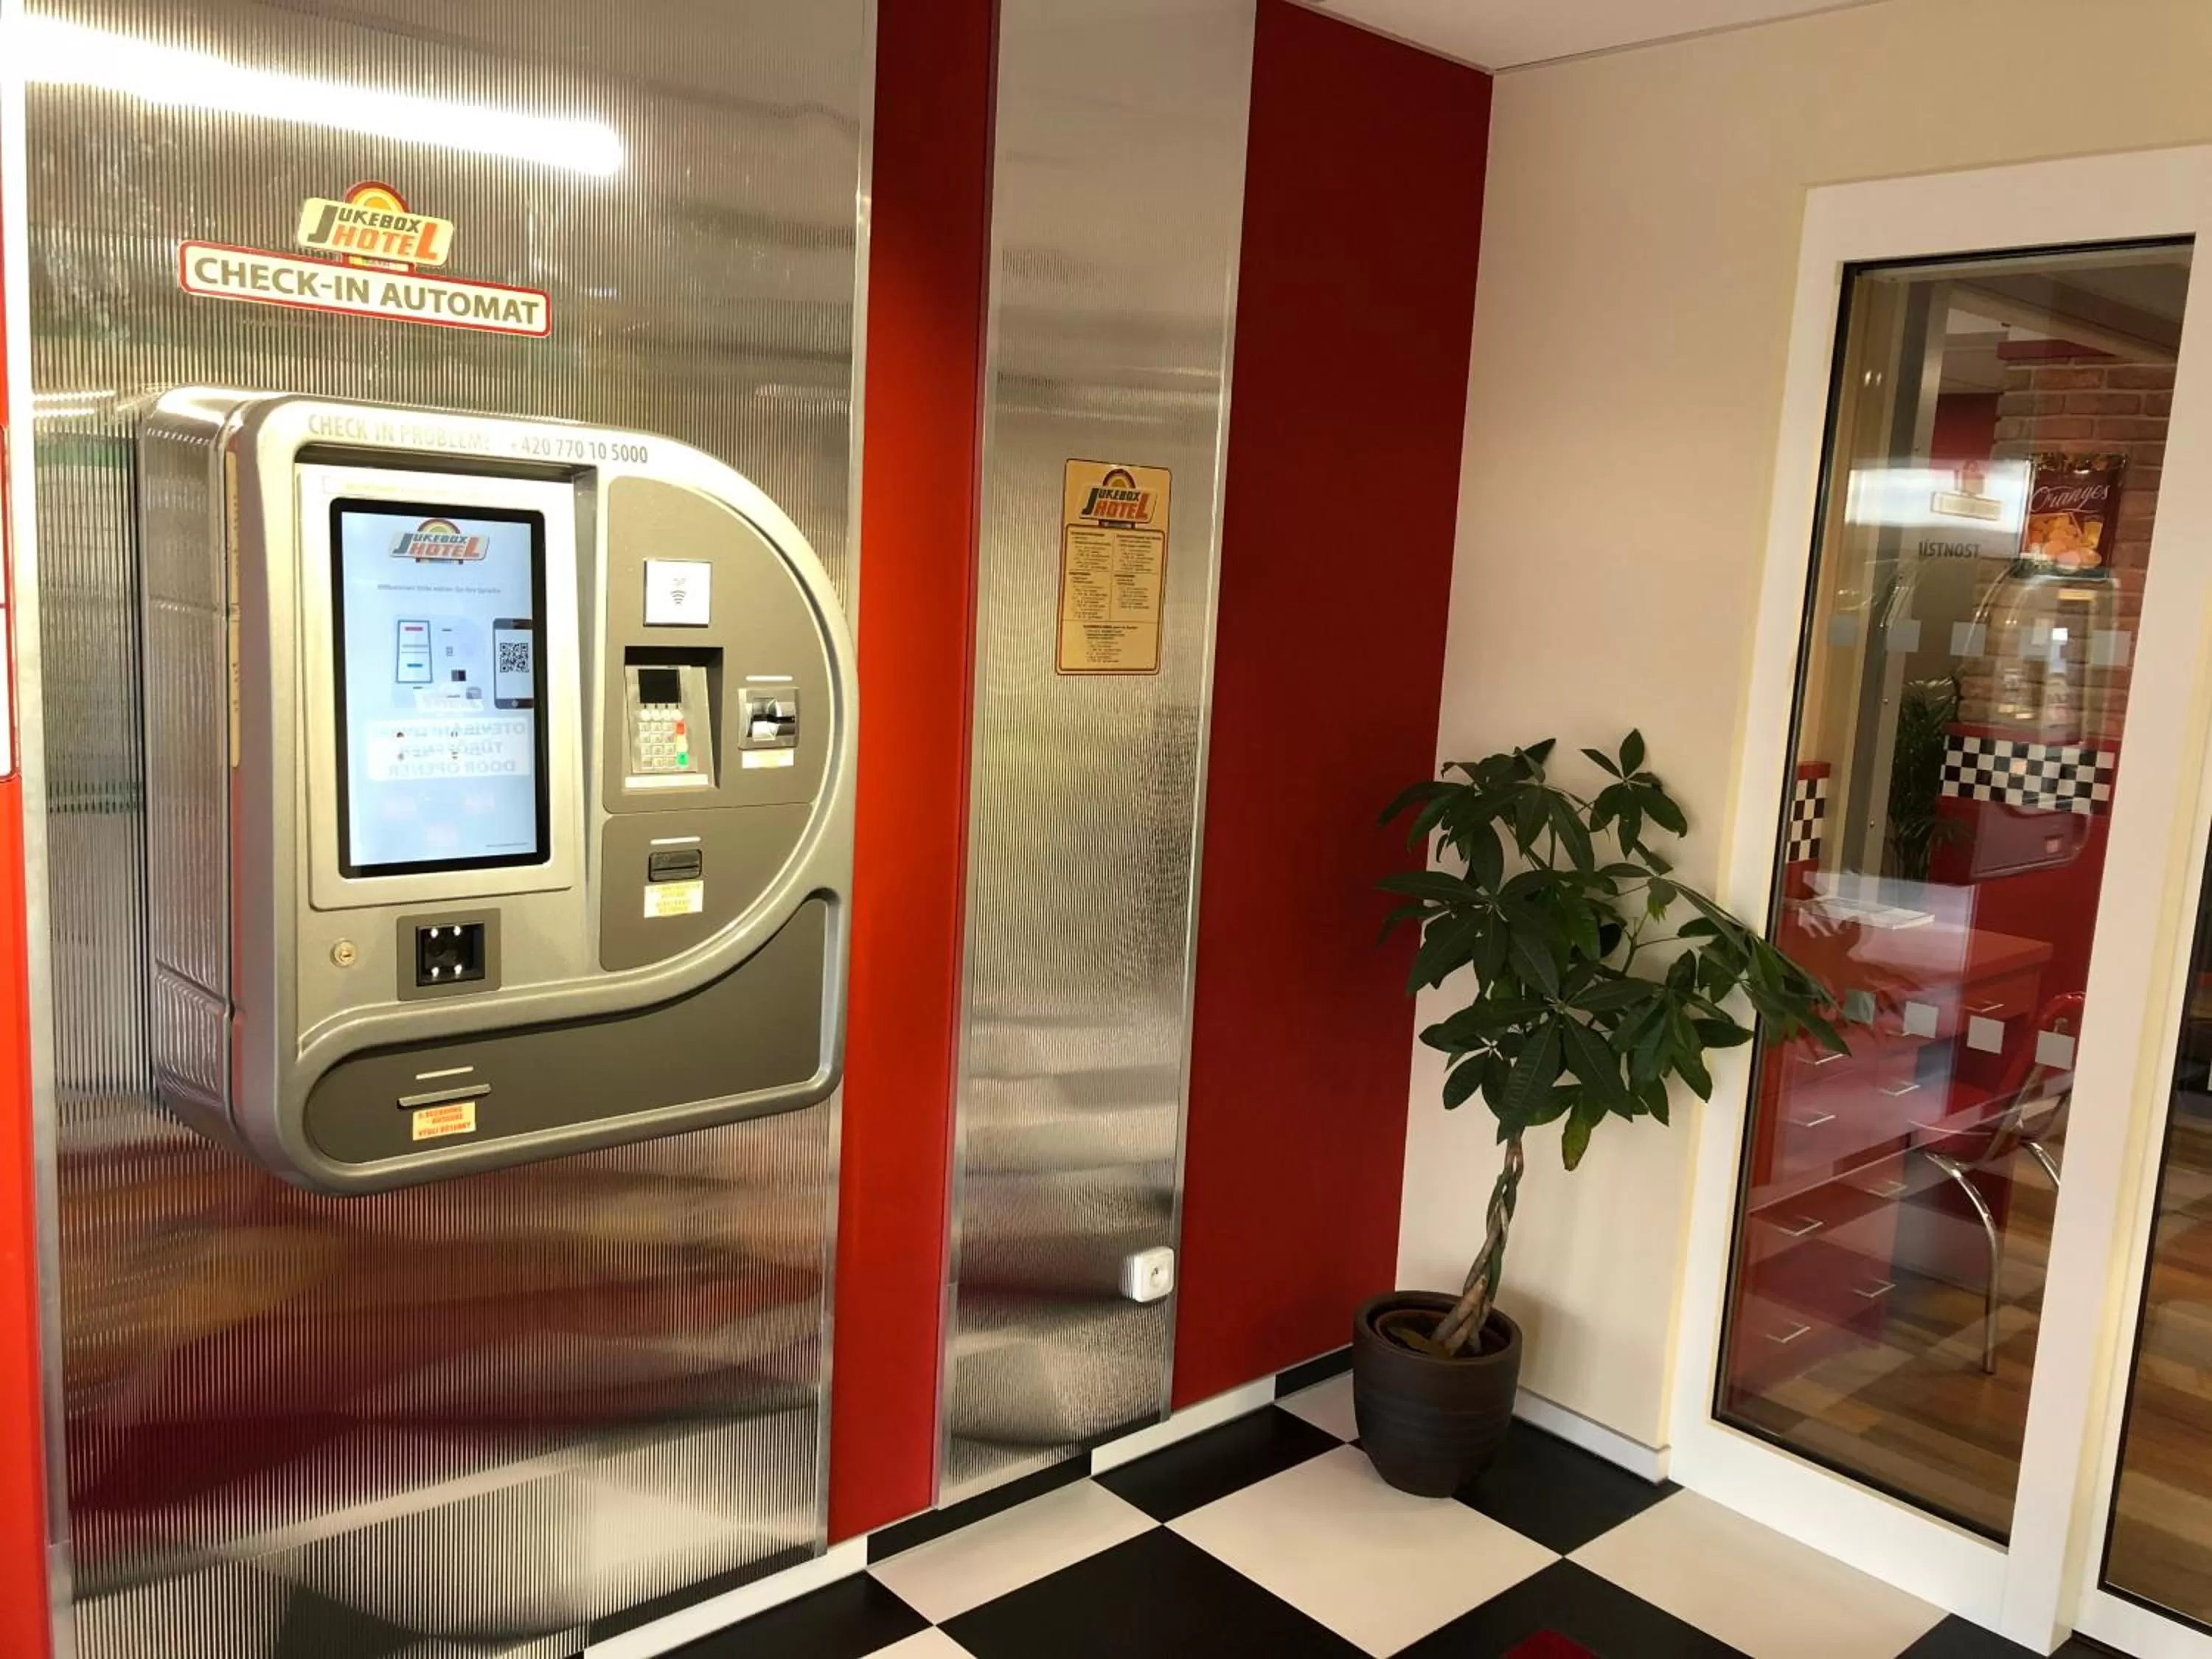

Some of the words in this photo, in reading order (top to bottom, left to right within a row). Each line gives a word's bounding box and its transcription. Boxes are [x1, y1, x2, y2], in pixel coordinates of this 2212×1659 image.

[308, 204, 423, 244] JUKEBOX
[333, 221, 438, 260] HOTEL
[194, 257, 369, 305] CHECK-IN
[380, 281, 539, 325] AUTOMAT
[308, 413, 367, 441] CHECK
[375, 421, 395, 444] IN
[555, 439, 585, 459] 770
[588, 441, 608, 462] 10
[611, 443, 648, 464] 5000
[1082, 487, 1141, 515] JUKEBOX
[1093, 492, 1149, 520] HOTEL
[393, 532, 468, 555] JUKEBOX
[409, 537, 481, 559] HOTEL
